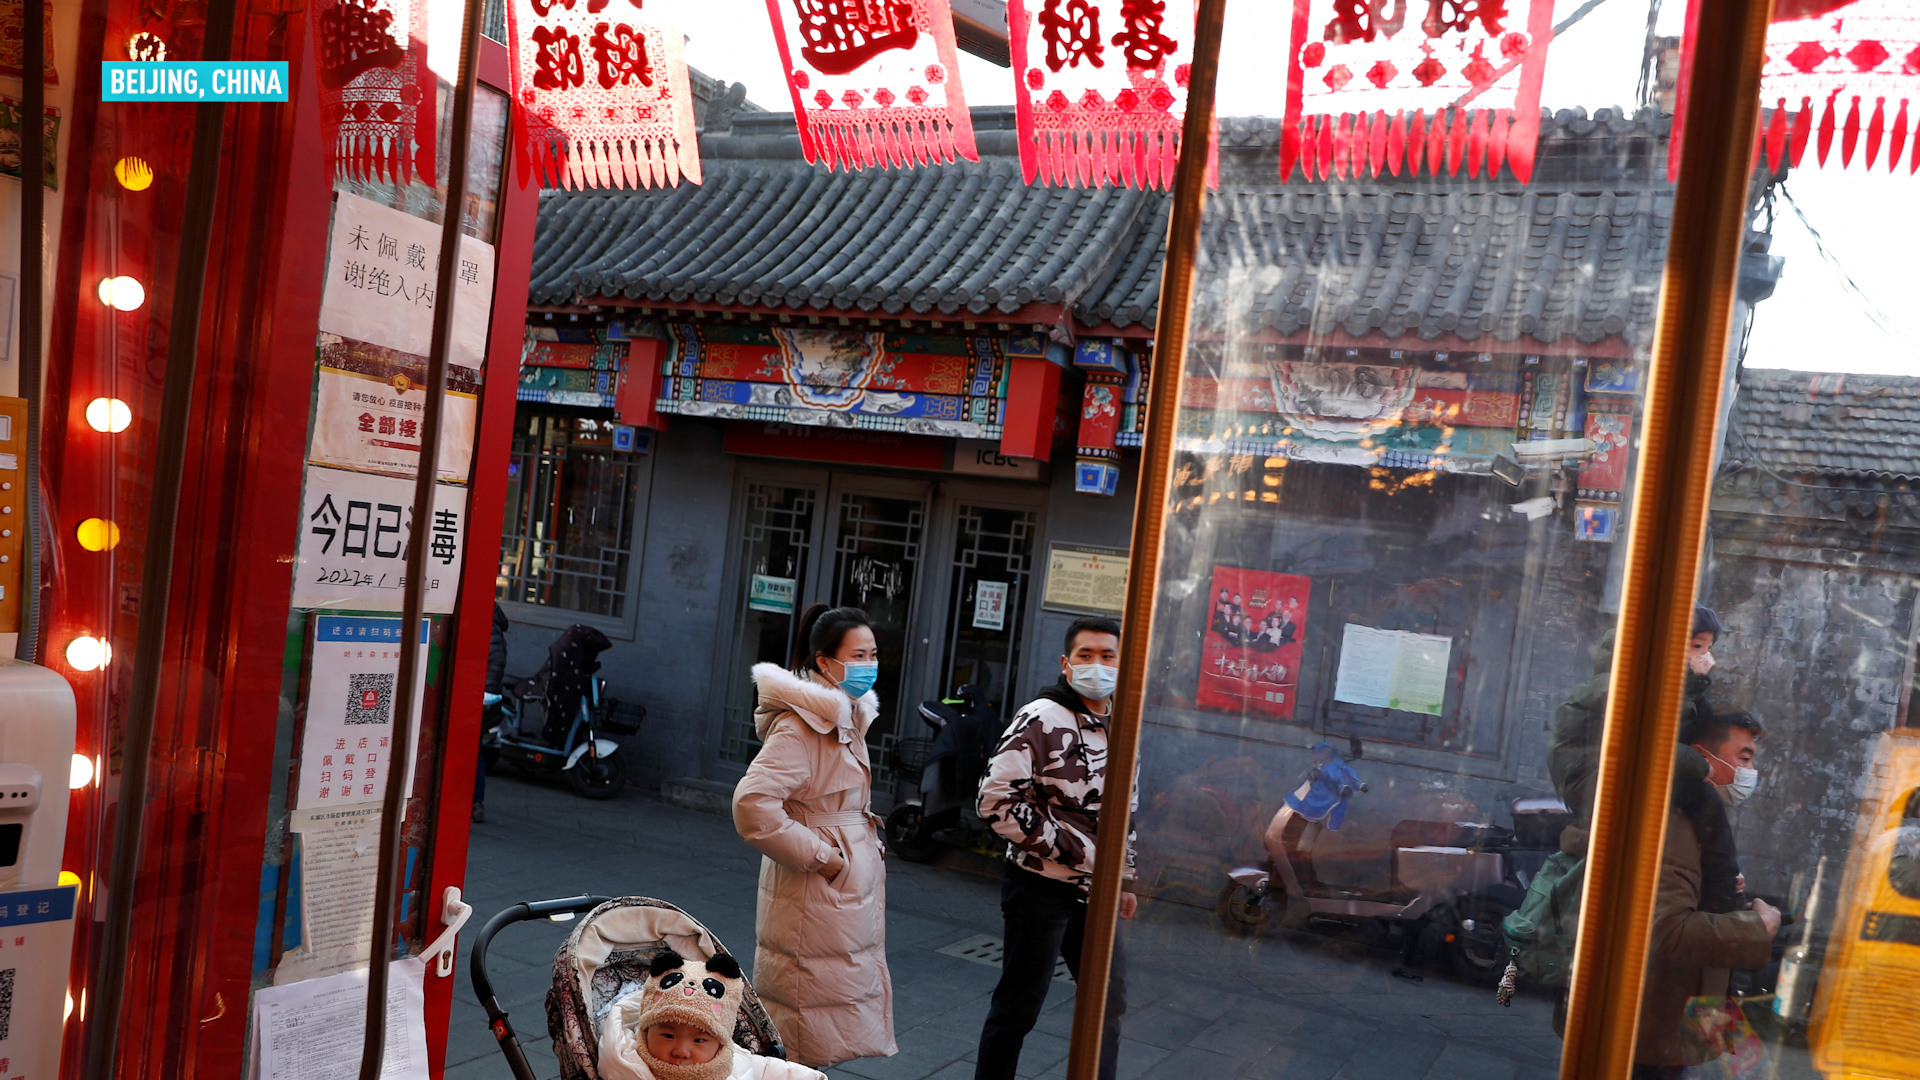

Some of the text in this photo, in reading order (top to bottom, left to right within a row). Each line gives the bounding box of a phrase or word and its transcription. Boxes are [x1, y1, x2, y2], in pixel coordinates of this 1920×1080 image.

[347, 225, 479, 286] 未佩戴罩
[343, 259, 435, 309] 谢绝入内
[388, 398, 427, 412] 疫苗接种
[358, 412, 424, 439] 全部接
[311, 493, 458, 565] 今日已毒
[979, 600, 1002, 612] 口罩
[322, 753, 391, 767] 佩戴口
[320, 768, 390, 783] 扫码登
